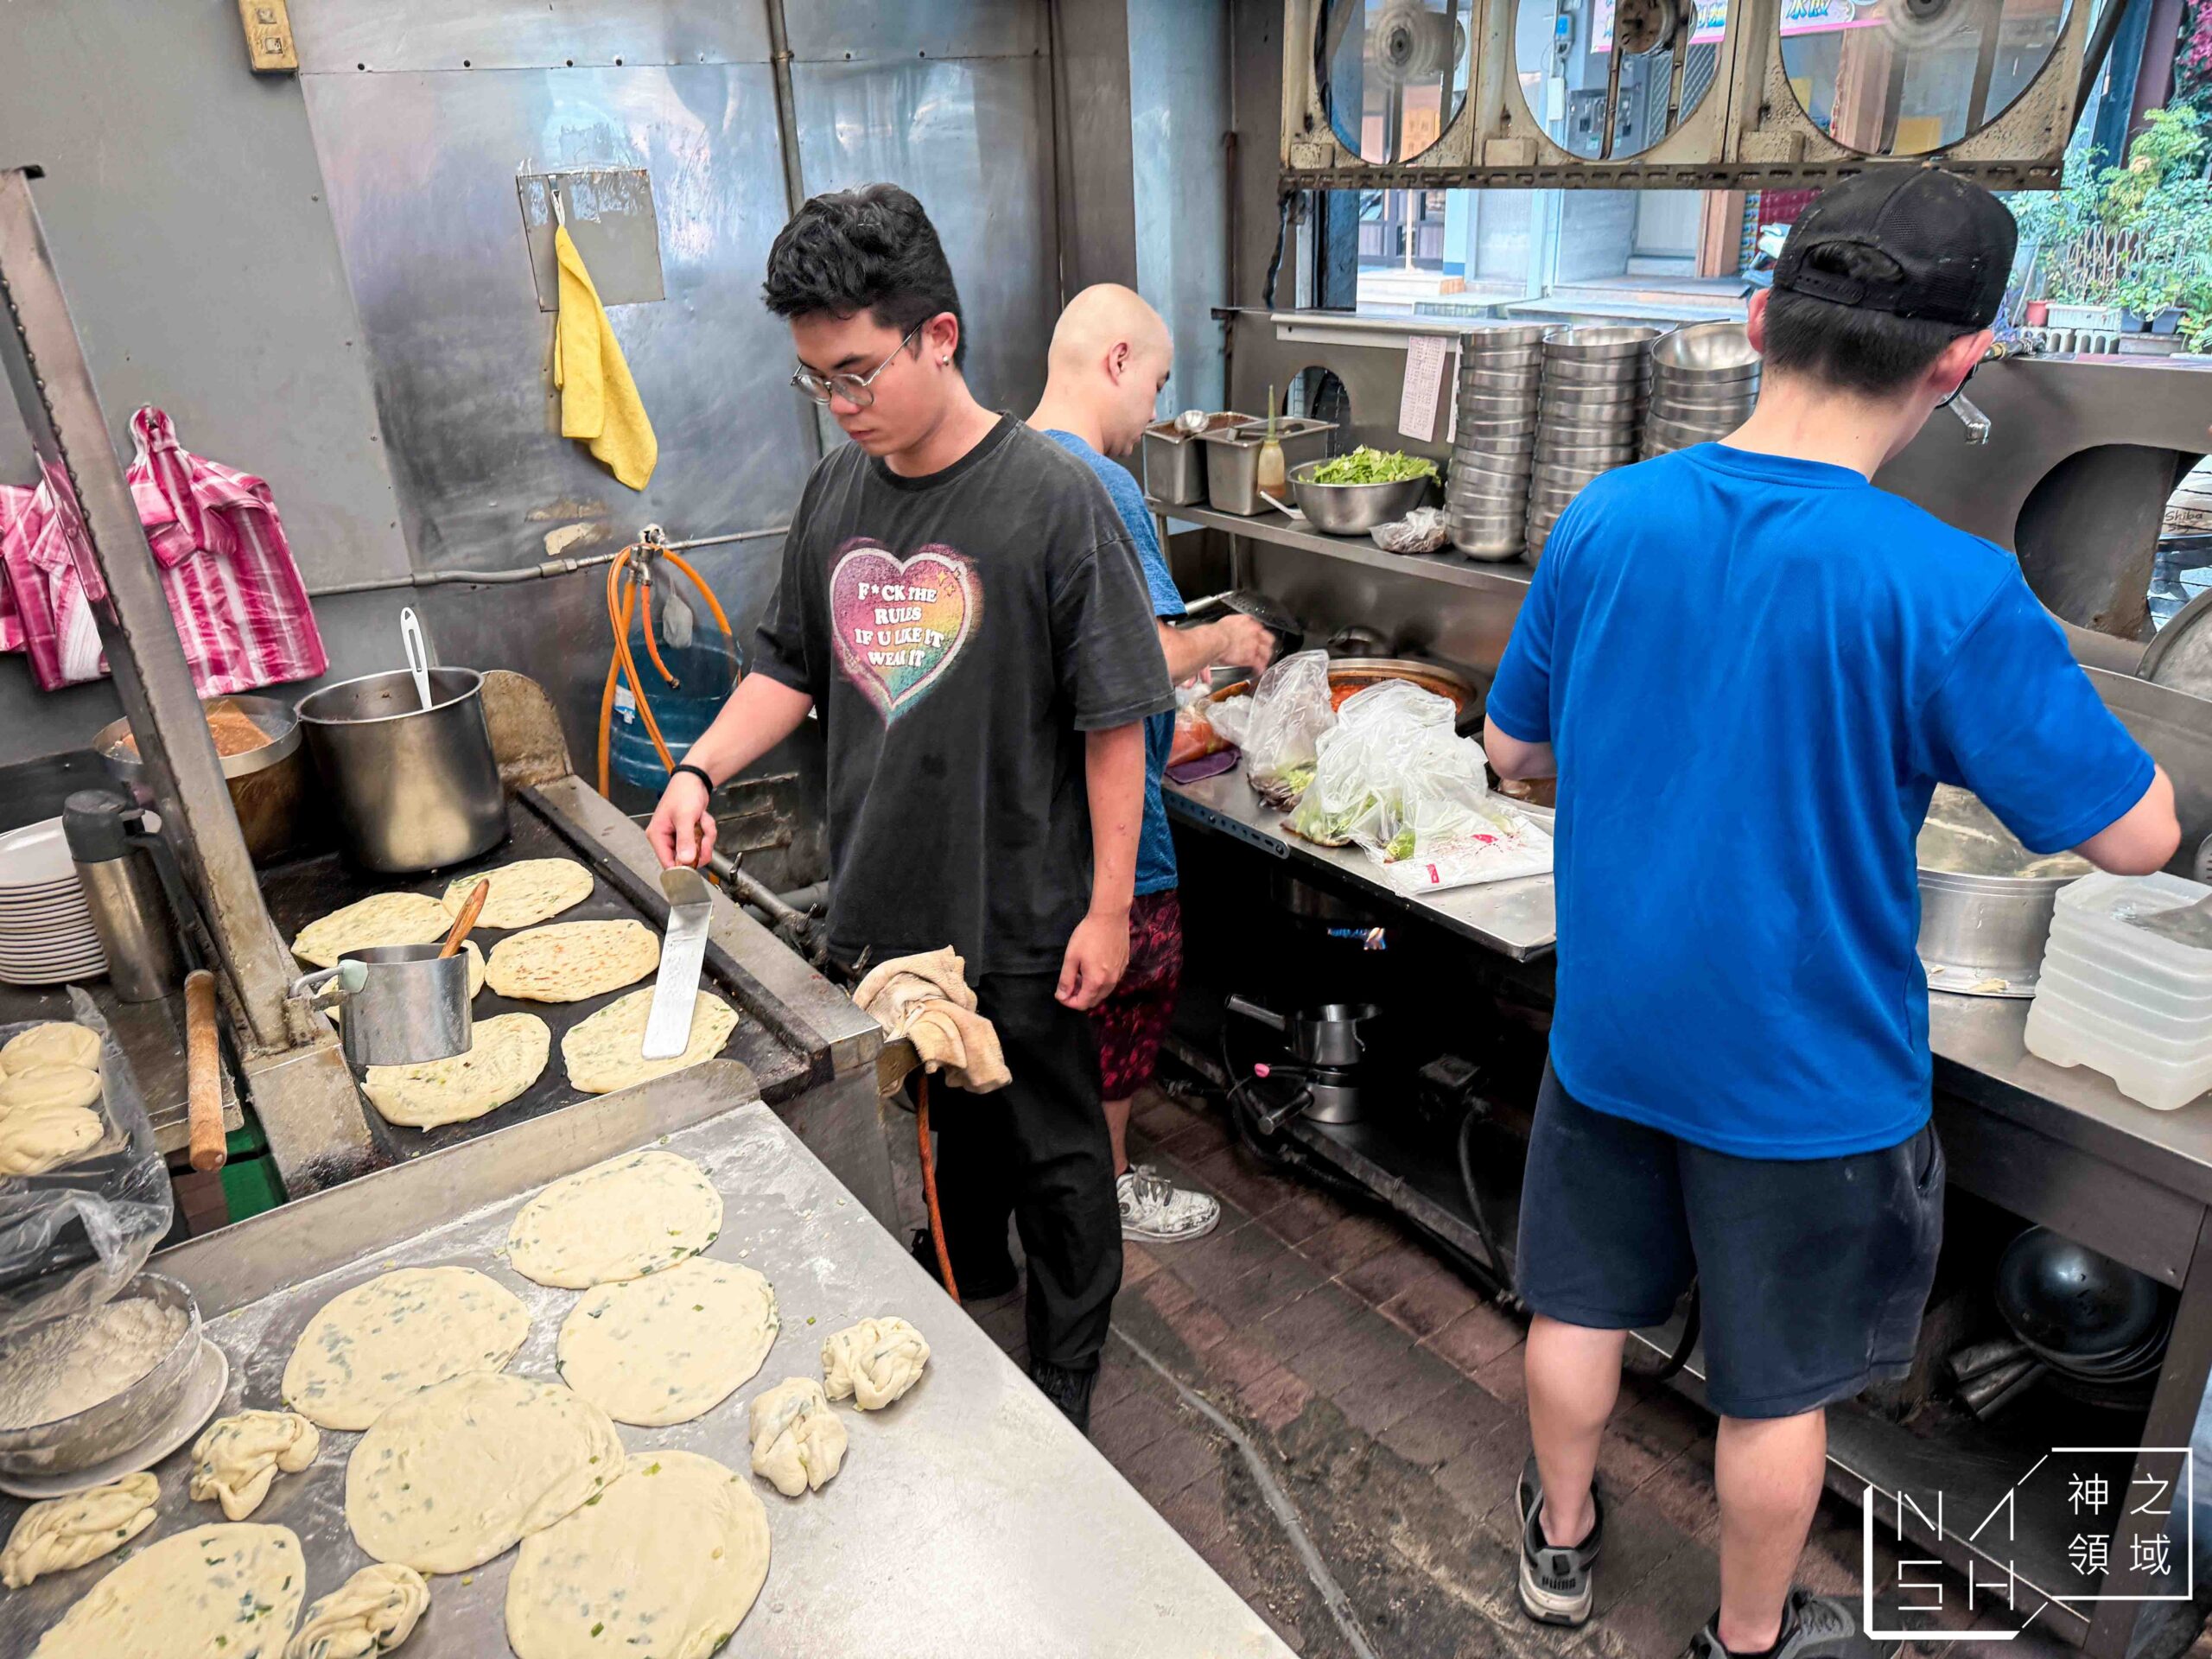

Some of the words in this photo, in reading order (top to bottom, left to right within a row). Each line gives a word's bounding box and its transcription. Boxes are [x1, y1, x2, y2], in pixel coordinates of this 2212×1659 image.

[2164, 511, 2203, 521] Shiba
[907, 587, 938, 603] THE
[874, 607, 922, 625] RULES
[855, 628, 874, 645] IF
[877, 631, 892, 646] U
[894, 627, 922, 645] LIKE
[924, 628, 944, 648] IT
[908, 649, 925, 667] IT
